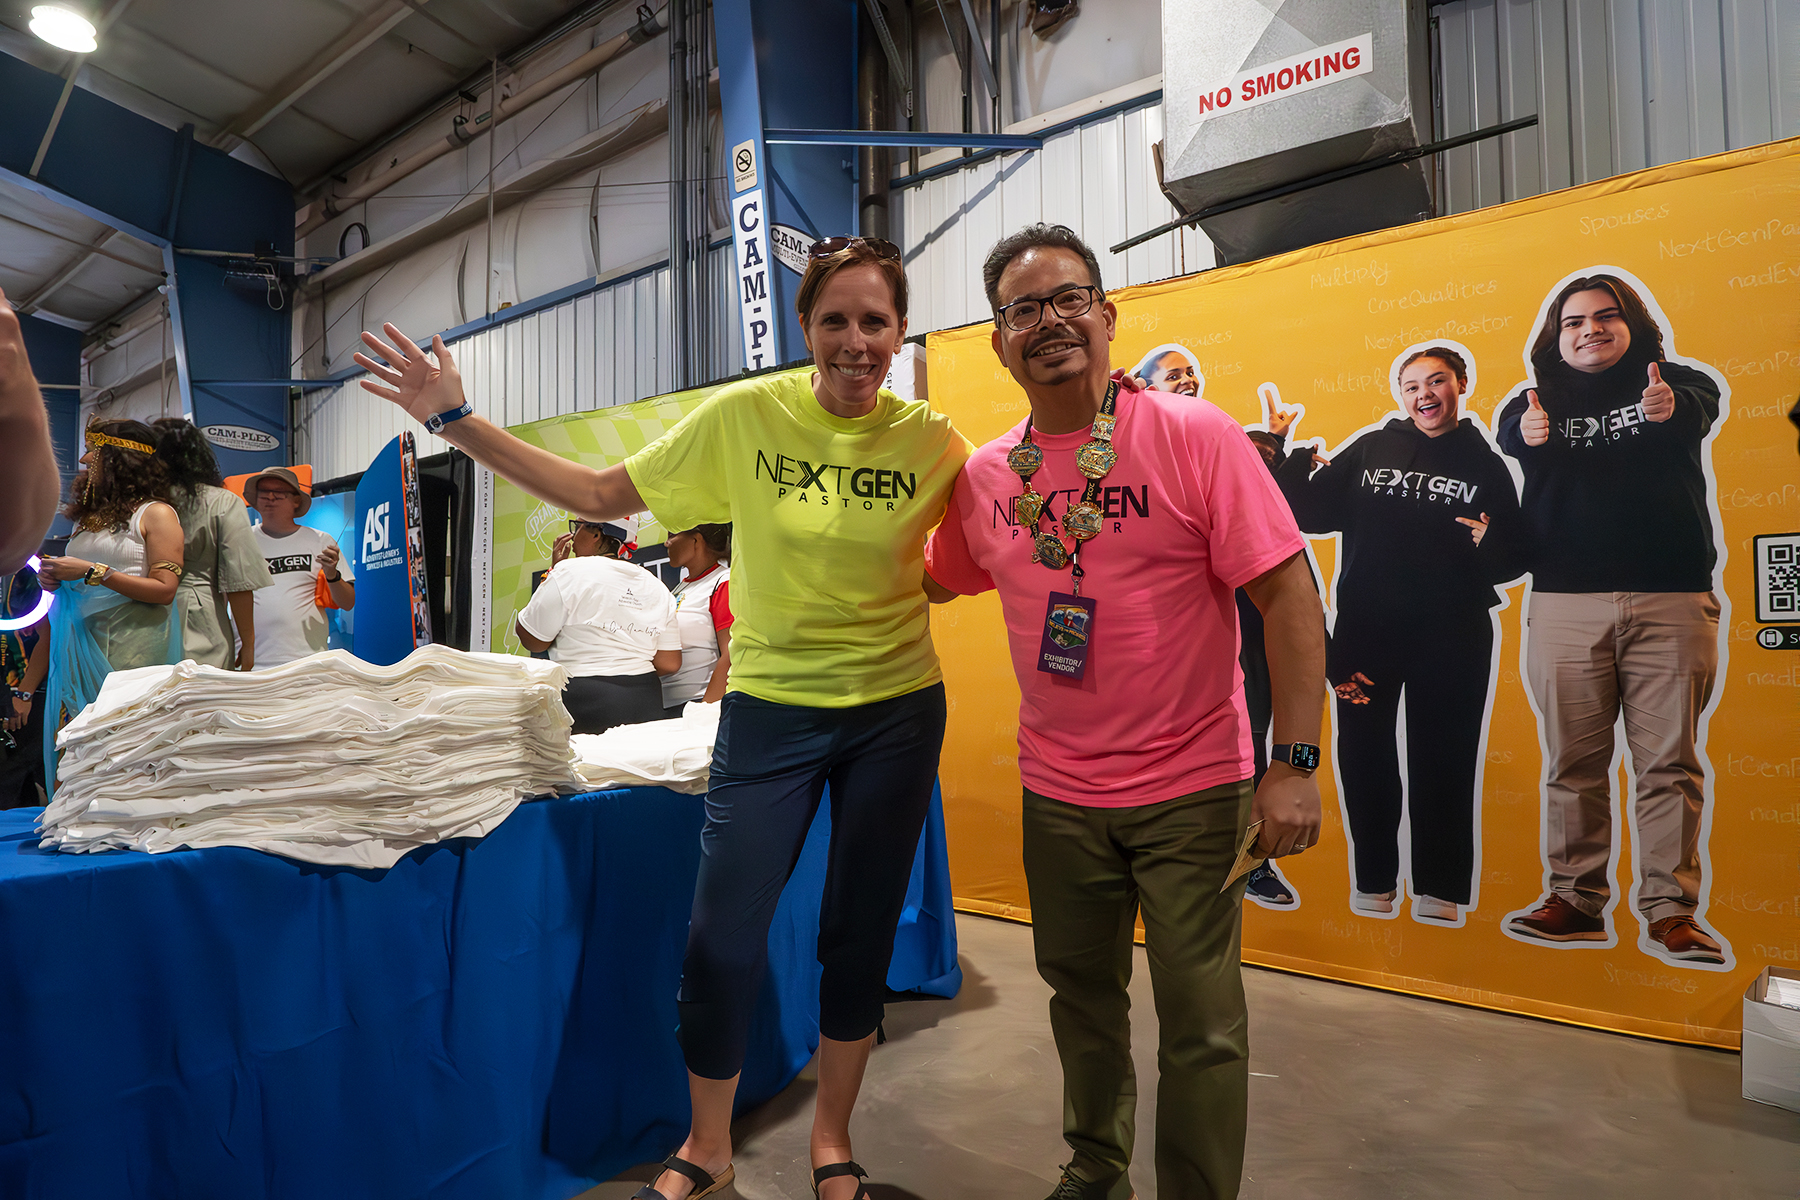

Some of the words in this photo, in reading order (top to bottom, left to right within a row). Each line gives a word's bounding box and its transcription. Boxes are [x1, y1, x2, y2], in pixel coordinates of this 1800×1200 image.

[1199, 87, 1232, 114] NO
[1241, 47, 1361, 101] SMOKING
[1579, 203, 1670, 236] Spouses
[771, 228, 812, 257] CAM-
[1310, 259, 1392, 288] Multiply
[1368, 279, 1498, 314] CoreQualities
[207, 427, 272, 443] CAM-PLEX
[778, 487, 895, 512] PASTOR
[1374, 486, 1452, 505] PASTOR
[1044, 653, 1083, 668] EXHIBITOR/
[1048, 661, 1075, 673] VENDOR
